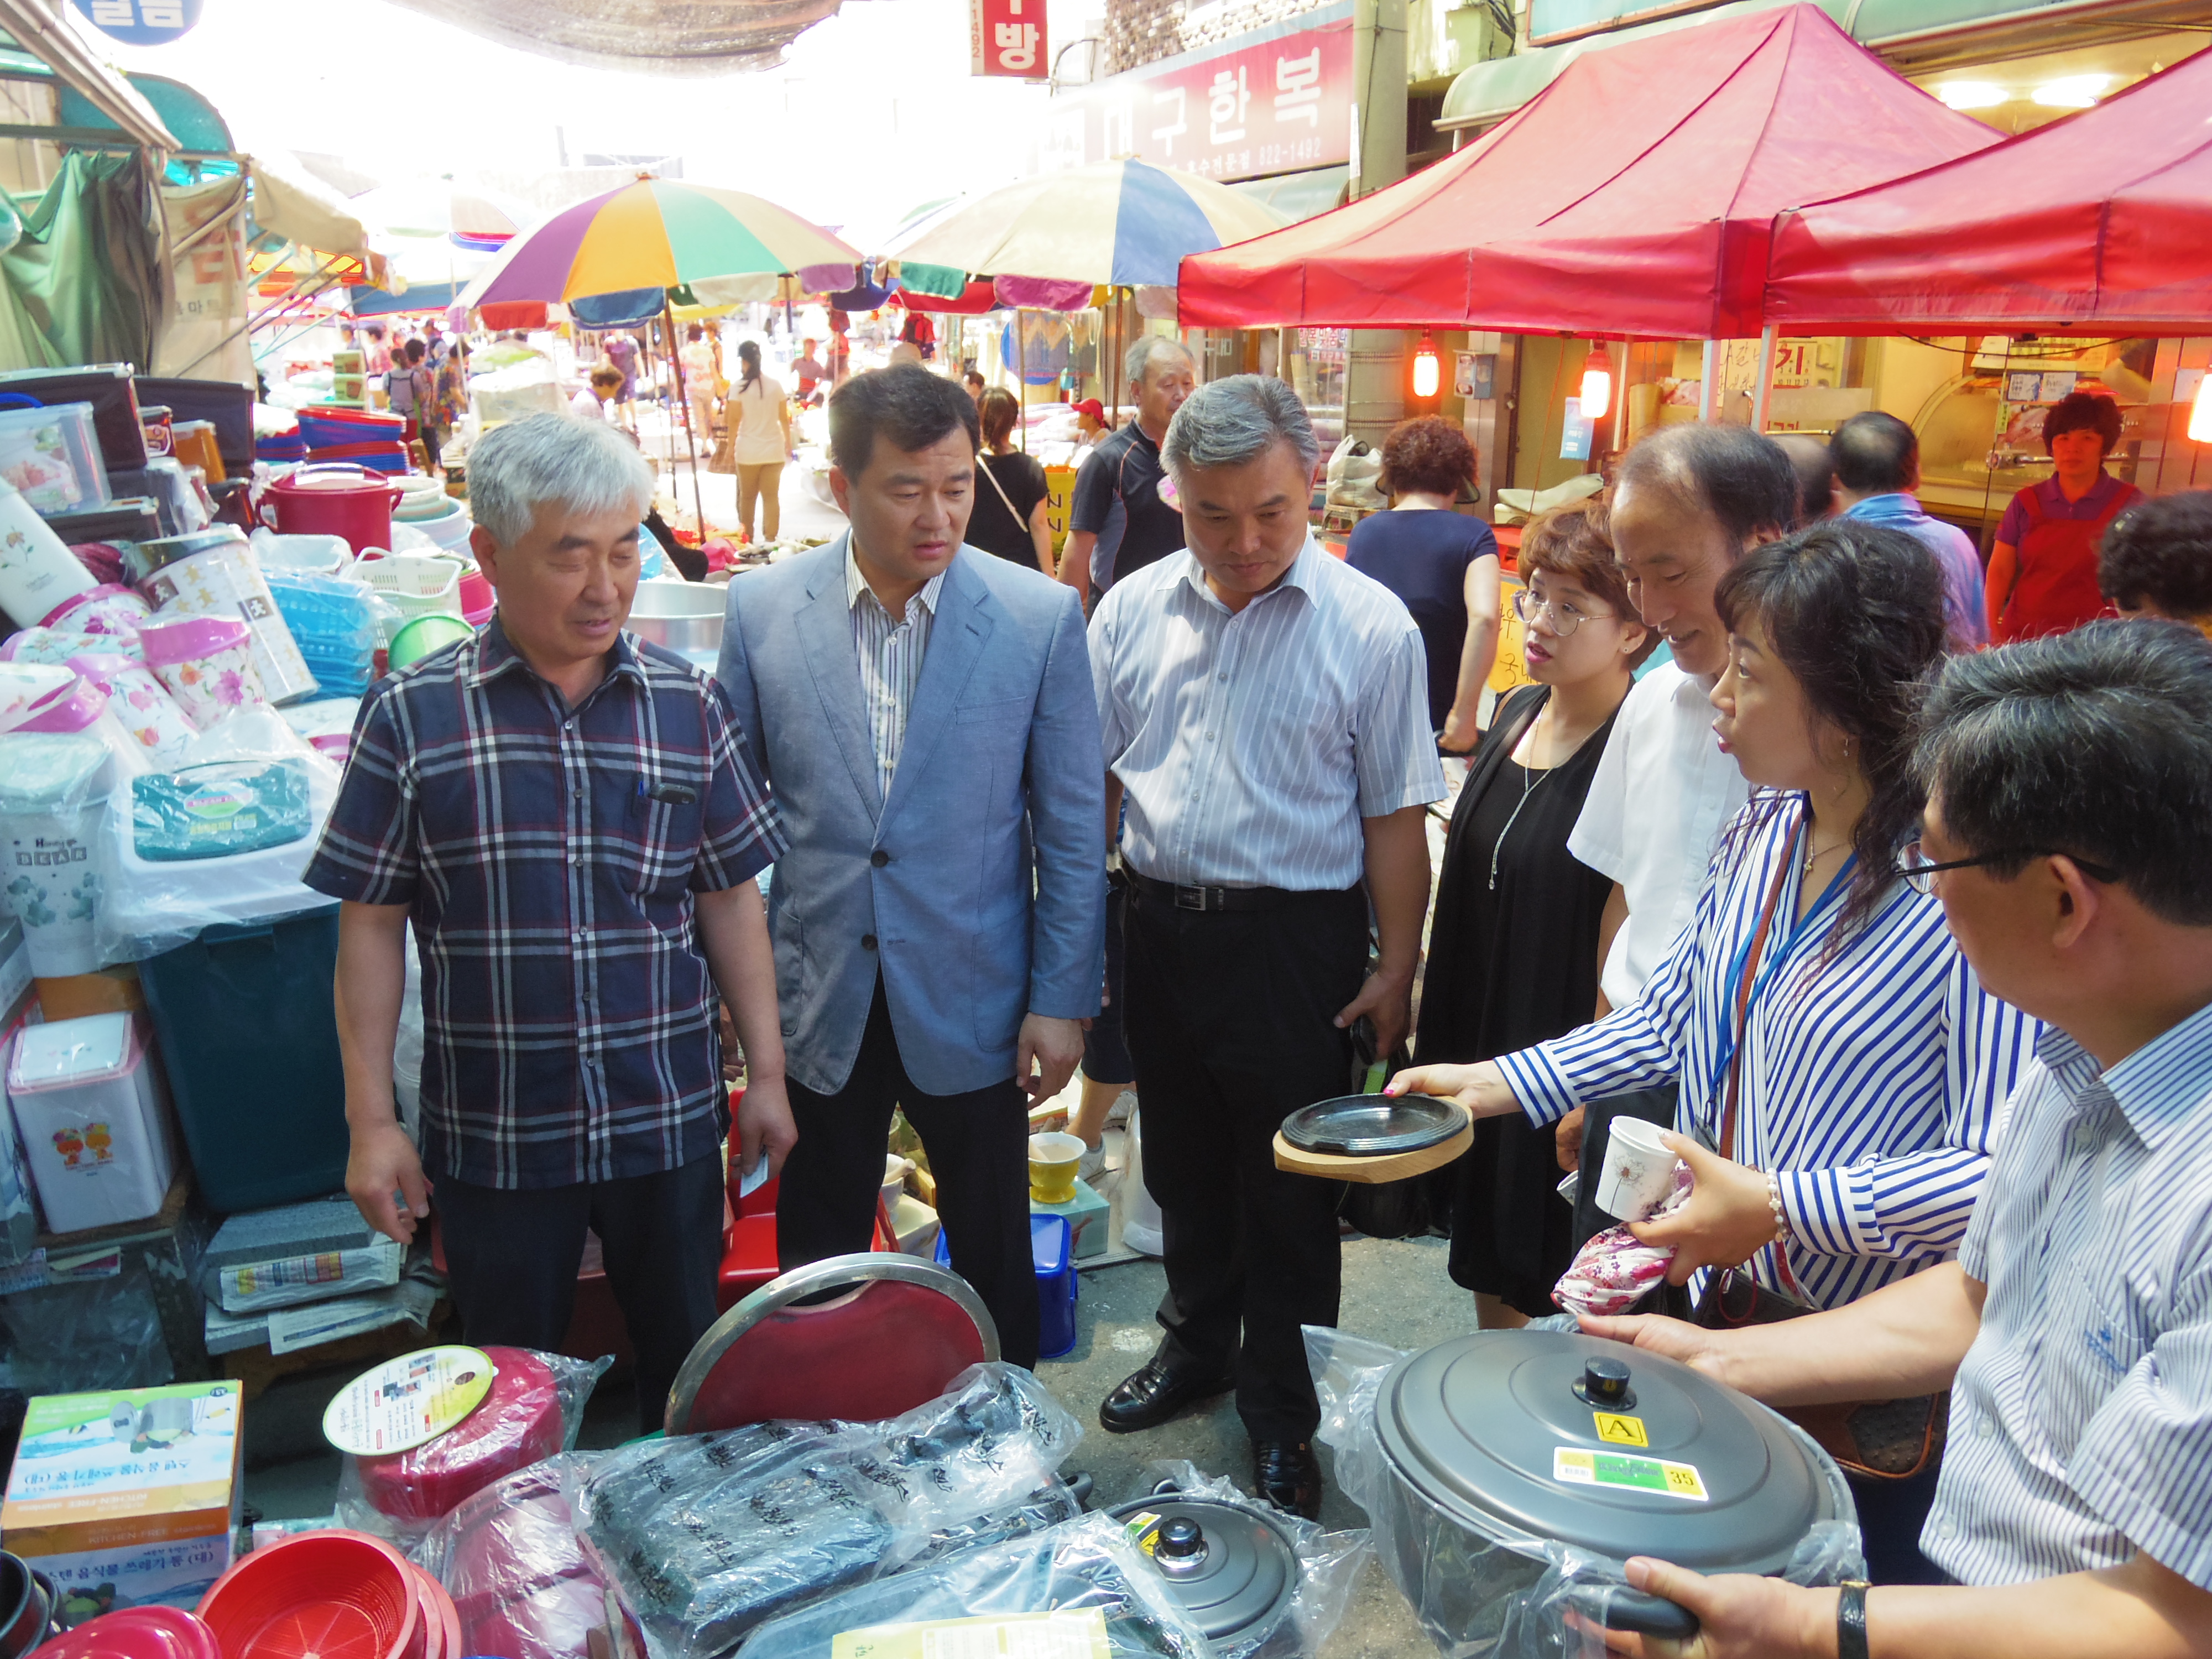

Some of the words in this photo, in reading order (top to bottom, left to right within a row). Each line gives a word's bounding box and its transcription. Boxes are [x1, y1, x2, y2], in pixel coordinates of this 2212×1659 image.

[1259, 137, 1321, 166] 822-1492
[1607, 1419, 1635, 1438] A
[74, 1466, 116, 1481] 쓰레기
[120, 1462, 159, 1476] 음식물
[1671, 1470, 1695, 1486] 35
[77, 1564, 119, 1580] 음식물
[125, 1558, 165, 1573] 쓰레기
